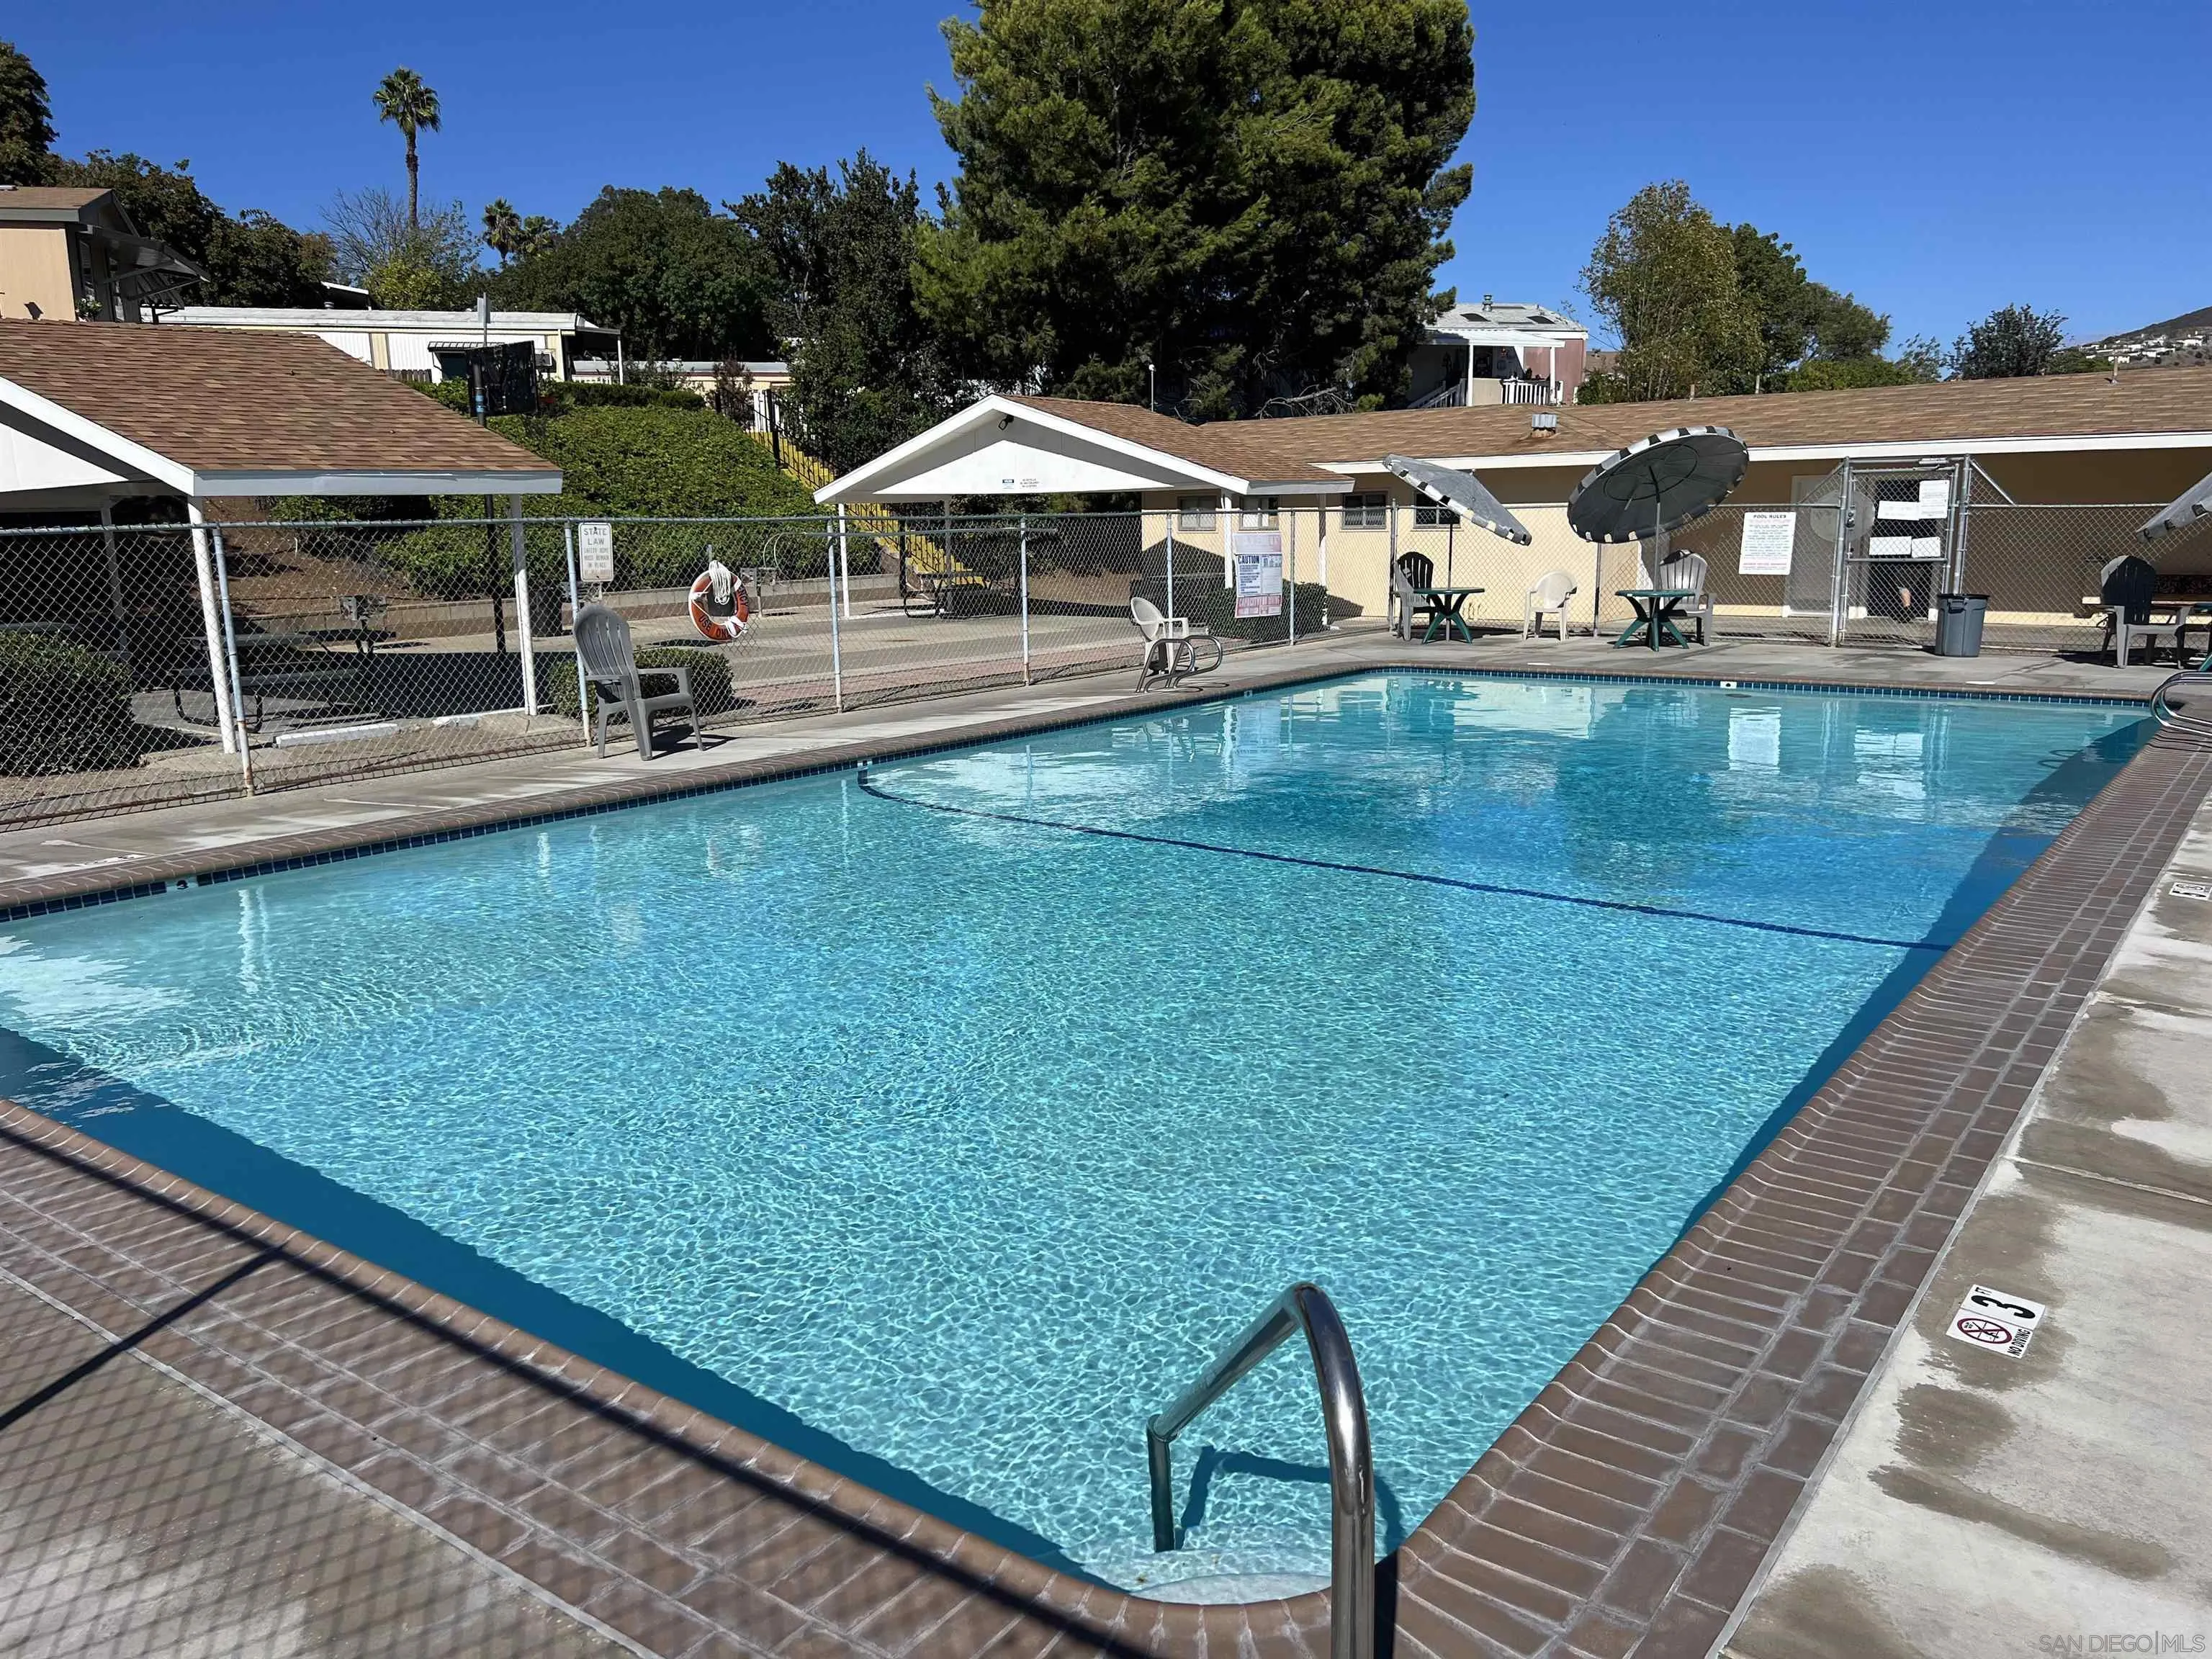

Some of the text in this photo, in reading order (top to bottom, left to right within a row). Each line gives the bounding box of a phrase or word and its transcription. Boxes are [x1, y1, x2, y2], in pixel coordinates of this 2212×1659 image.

[1238, 555, 1259, 564] CAUTION
[699, 615, 732, 639] USE ONL
[1971, 1287, 2036, 1318] 3 FT
[2007, 1328, 2031, 1356] NO DIVING
